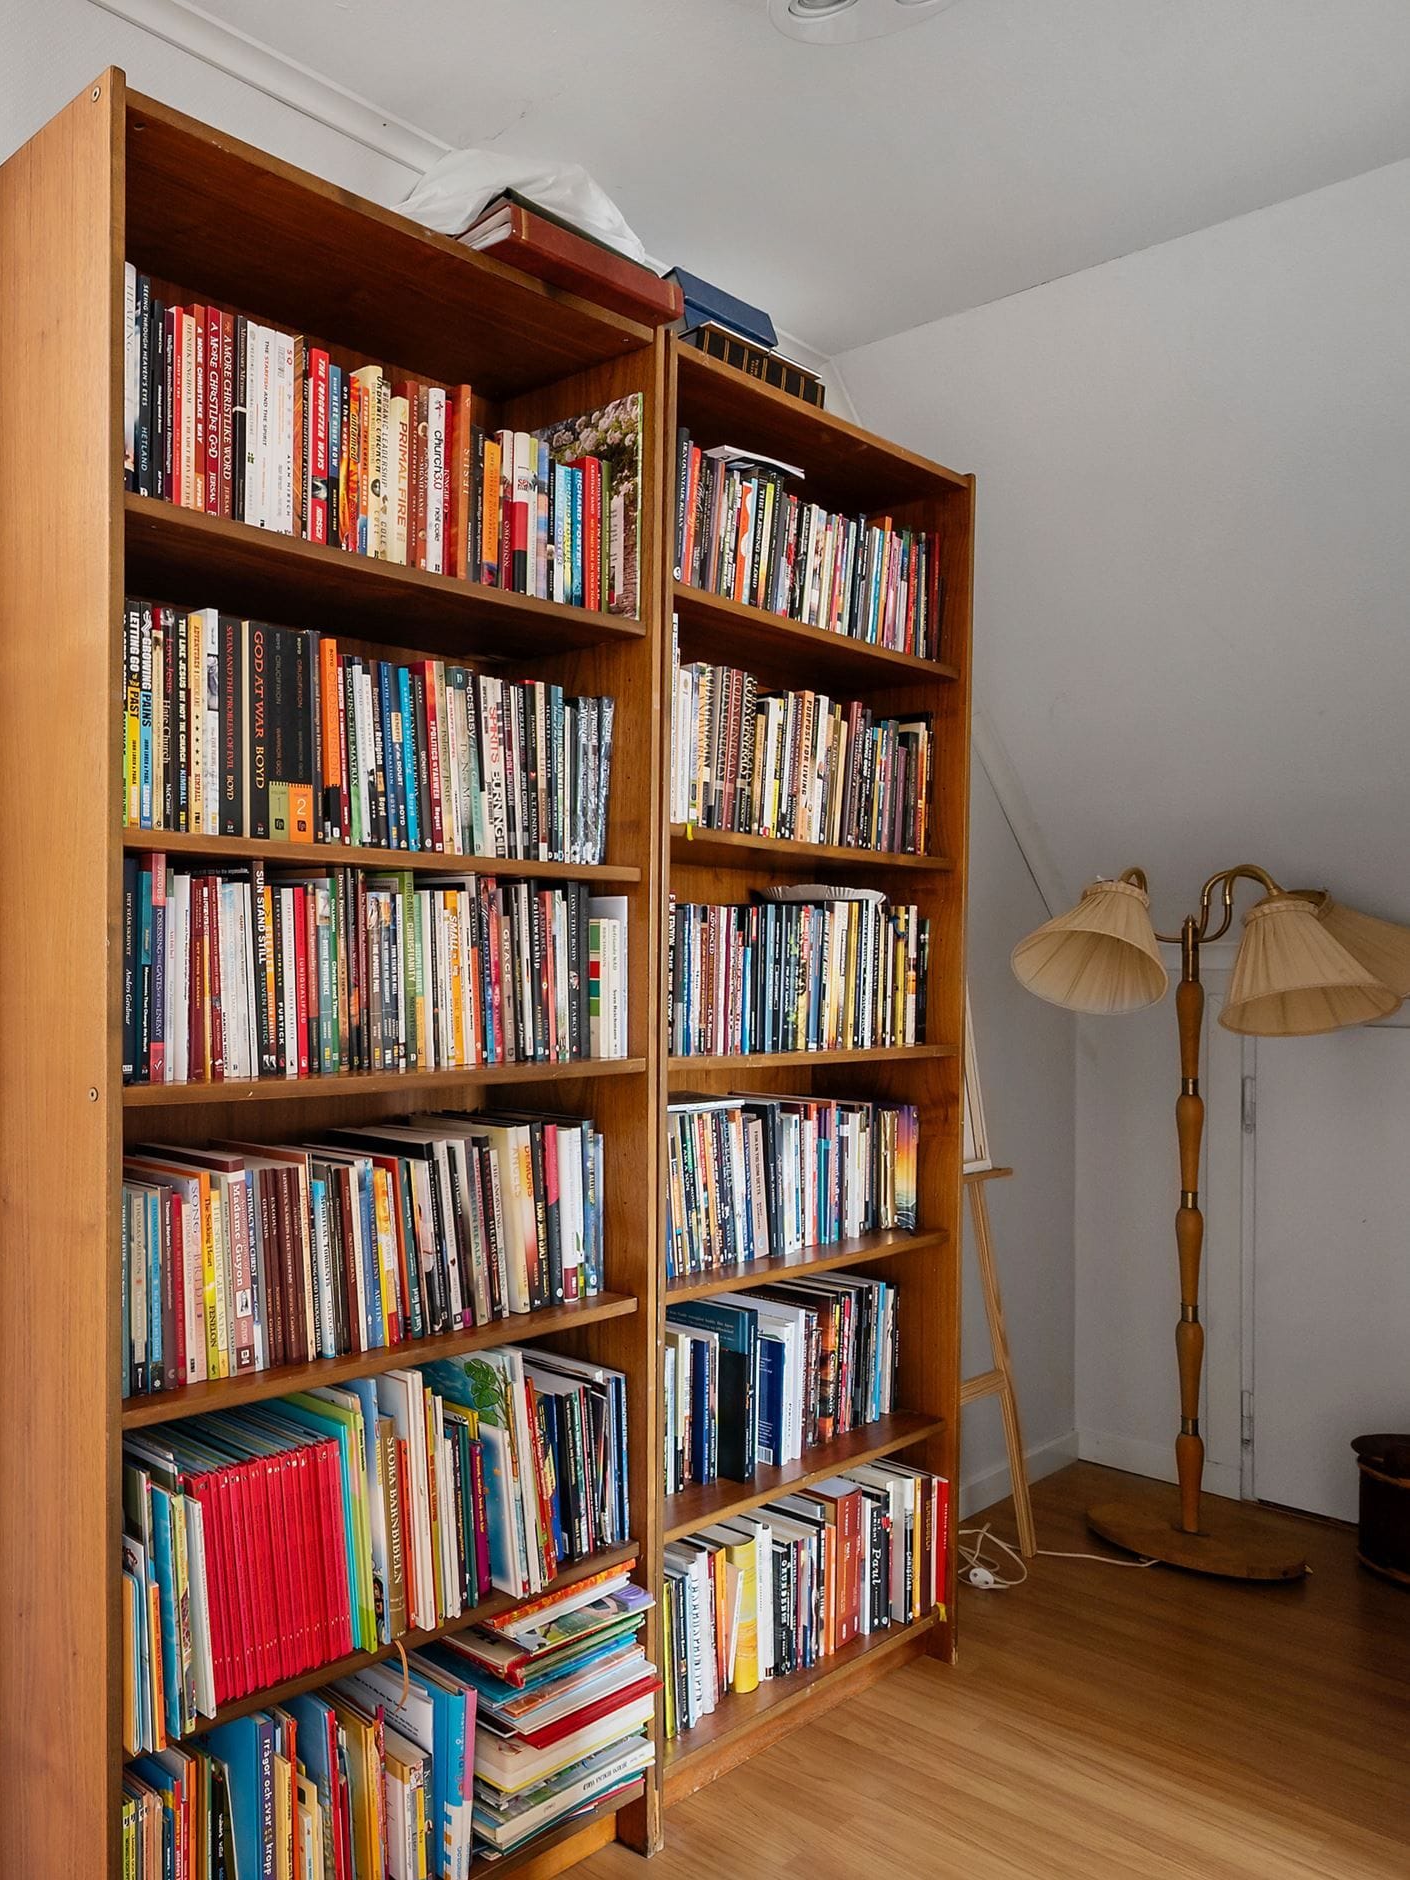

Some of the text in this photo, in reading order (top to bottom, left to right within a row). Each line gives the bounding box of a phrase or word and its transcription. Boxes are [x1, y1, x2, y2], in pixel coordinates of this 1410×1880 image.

[209, 322, 218, 458] A MORE CHRISTLIKE GOD
[224, 335, 232, 480] A MORE CHRISTLIKE WORD
[350, 414, 358, 459] untamed
[397, 422, 407, 527] PRIMAL FIRE
[755, 510, 764, 552] BLESSING
[130, 612, 140, 672] LETTING GO
[142, 638, 152, 689] GROWING
[130, 691, 138, 719] PAST
[254, 631, 264, 738] GOD AT WAR
[372, 688, 381, 721] Repenting
[142, 694, 151, 727] PAINS
[163, 700, 171, 763] Hate Church
[327, 672, 338, 777] CROSS VISION
[346, 668, 358, 786] ESCAPING THE MATRIX
[466, 686, 475, 737] ecstasy
[227, 738, 233, 749] OF
[256, 746, 264, 788] BOYD
[374, 732, 383, 765] Religion
[801, 700, 813, 795] PURPOSE FOR LIVING
[256, 870, 266, 964] SUN STAND STILL
[449, 915, 458, 950] SMALL
[407, 922, 415, 981] CHRISTIANITY
[191, 1186, 200, 1233] SONG
[205, 1214, 213, 1243] Seeking
[246, 1189, 254, 1227] INTIMACY
[206, 1245, 214, 1267] Heart
[232, 1185, 245, 1286] Madame Guyon
[489, 1220, 499, 1270] HERMON
[249, 1248, 257, 1276] CHRIST
[209, 1305, 217, 1347] FENELON
[386, 1437, 405, 1584] STORA BARNBIBELN
[871, 1548, 882, 1586] Paul
[262, 1739, 272, 1826] Frågor och svar
[264, 1844, 273, 1875] kropp
